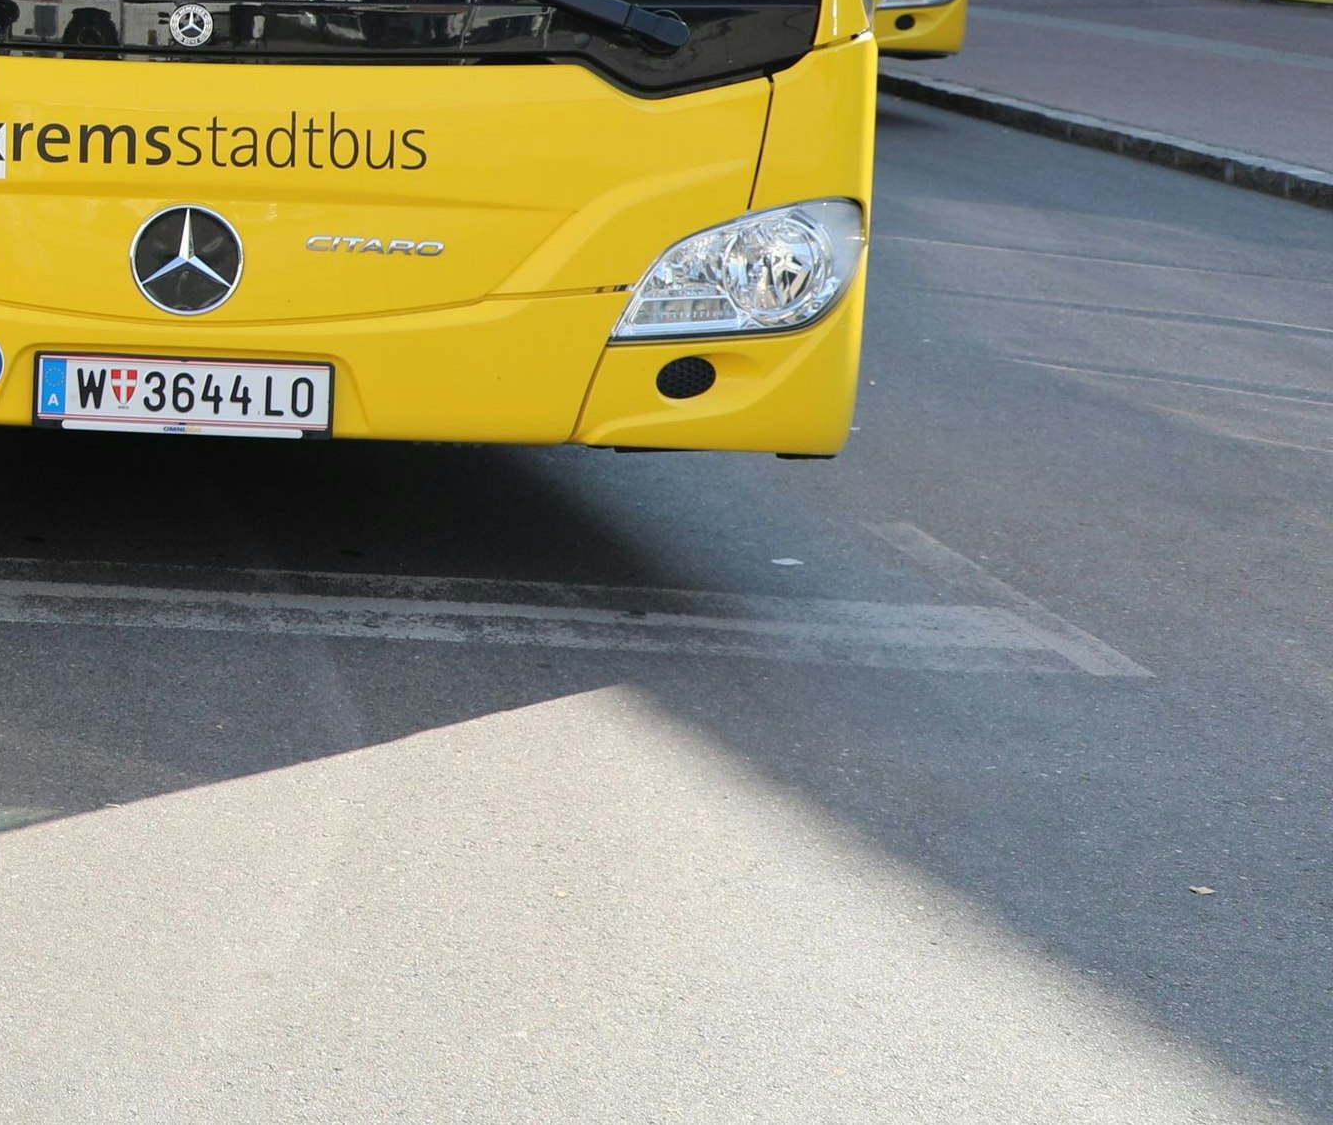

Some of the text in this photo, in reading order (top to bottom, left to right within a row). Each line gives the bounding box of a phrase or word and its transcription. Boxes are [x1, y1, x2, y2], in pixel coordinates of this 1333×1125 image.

[305, 235, 446, 257] CITARO
[47, 393, 60, 407] A
[77, 368, 107, 409] W
